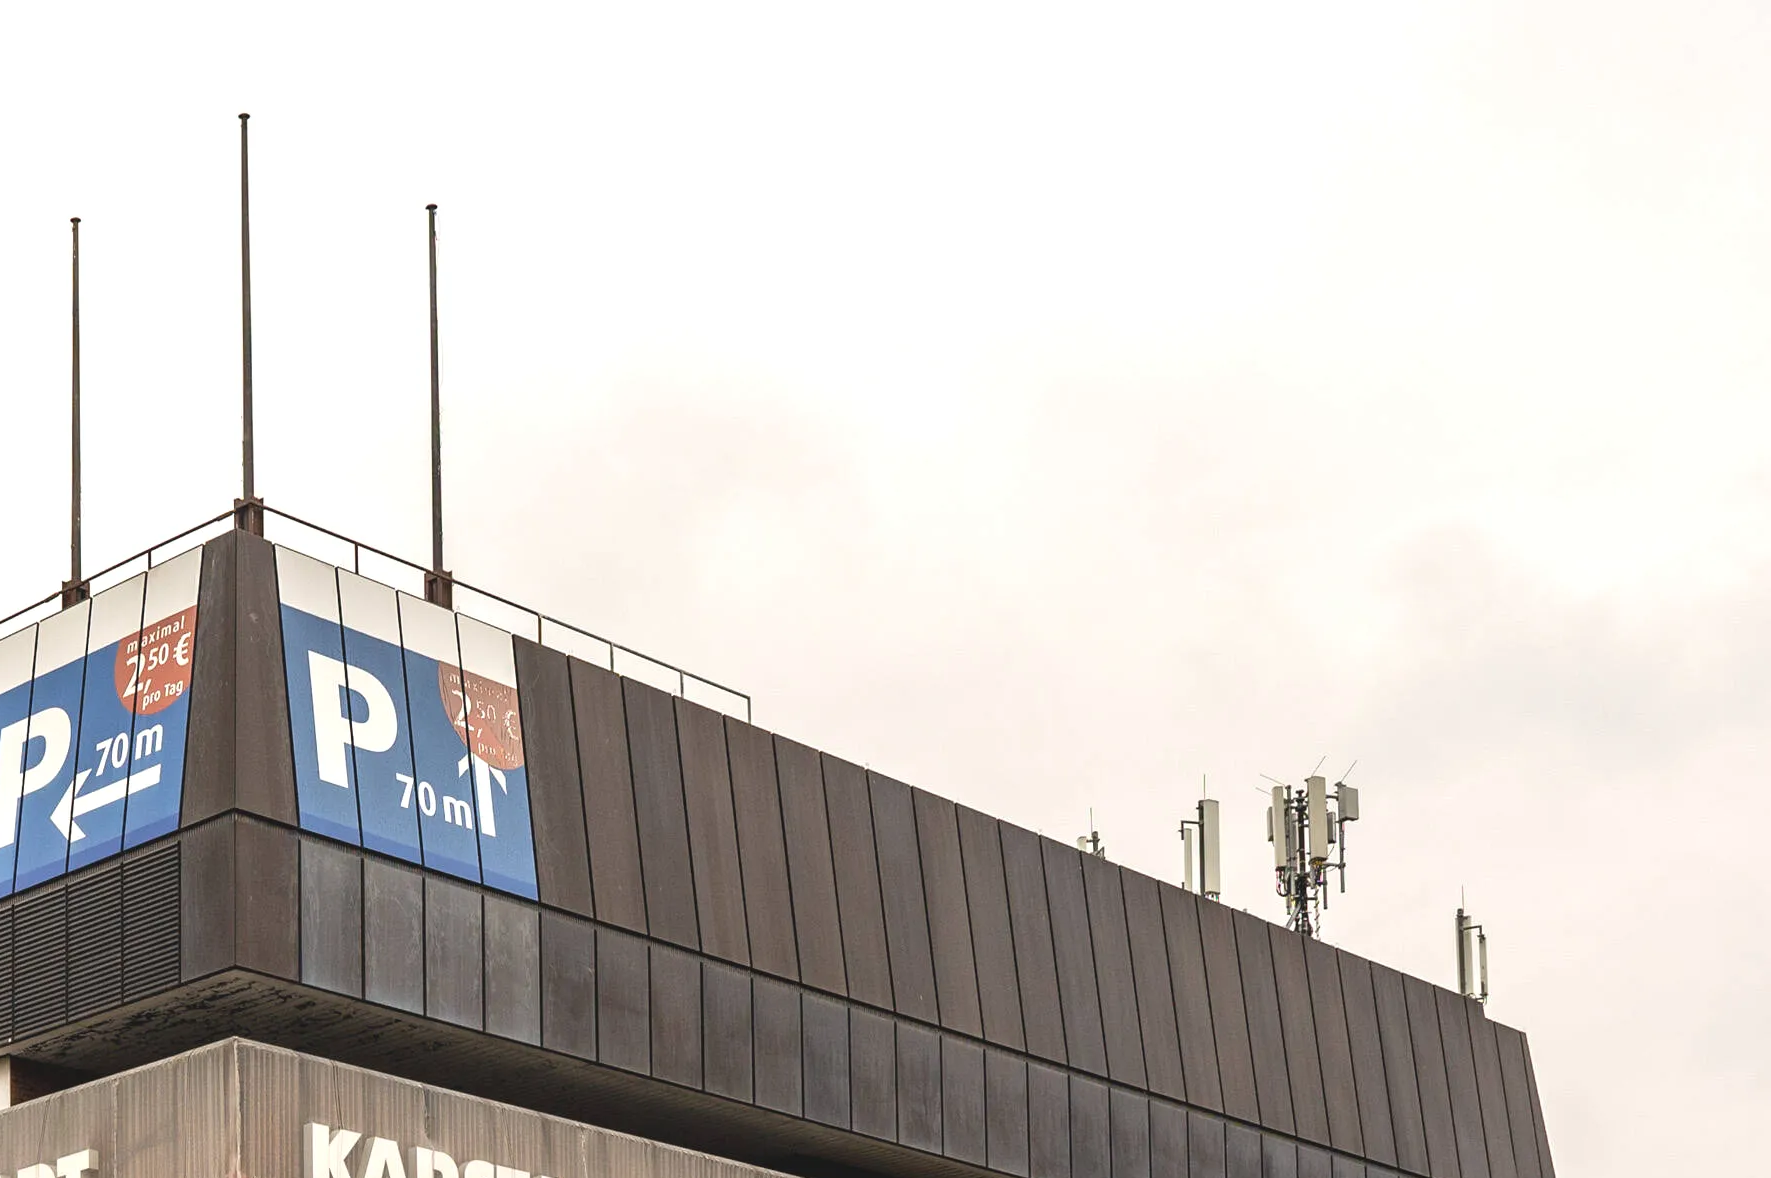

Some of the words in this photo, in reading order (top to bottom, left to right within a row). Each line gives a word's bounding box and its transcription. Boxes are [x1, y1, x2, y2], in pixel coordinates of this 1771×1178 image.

[126, 615, 185, 654] maximal
[172, 631, 192, 667] €
[141, 690, 161, 711] pro
[164, 680, 184, 697] Tag
[307, 649, 398, 789] P
[95, 731, 128, 777] 70
[133, 723, 164, 761] m
[395, 772, 437, 818] 70
[443, 793, 474, 830] m
